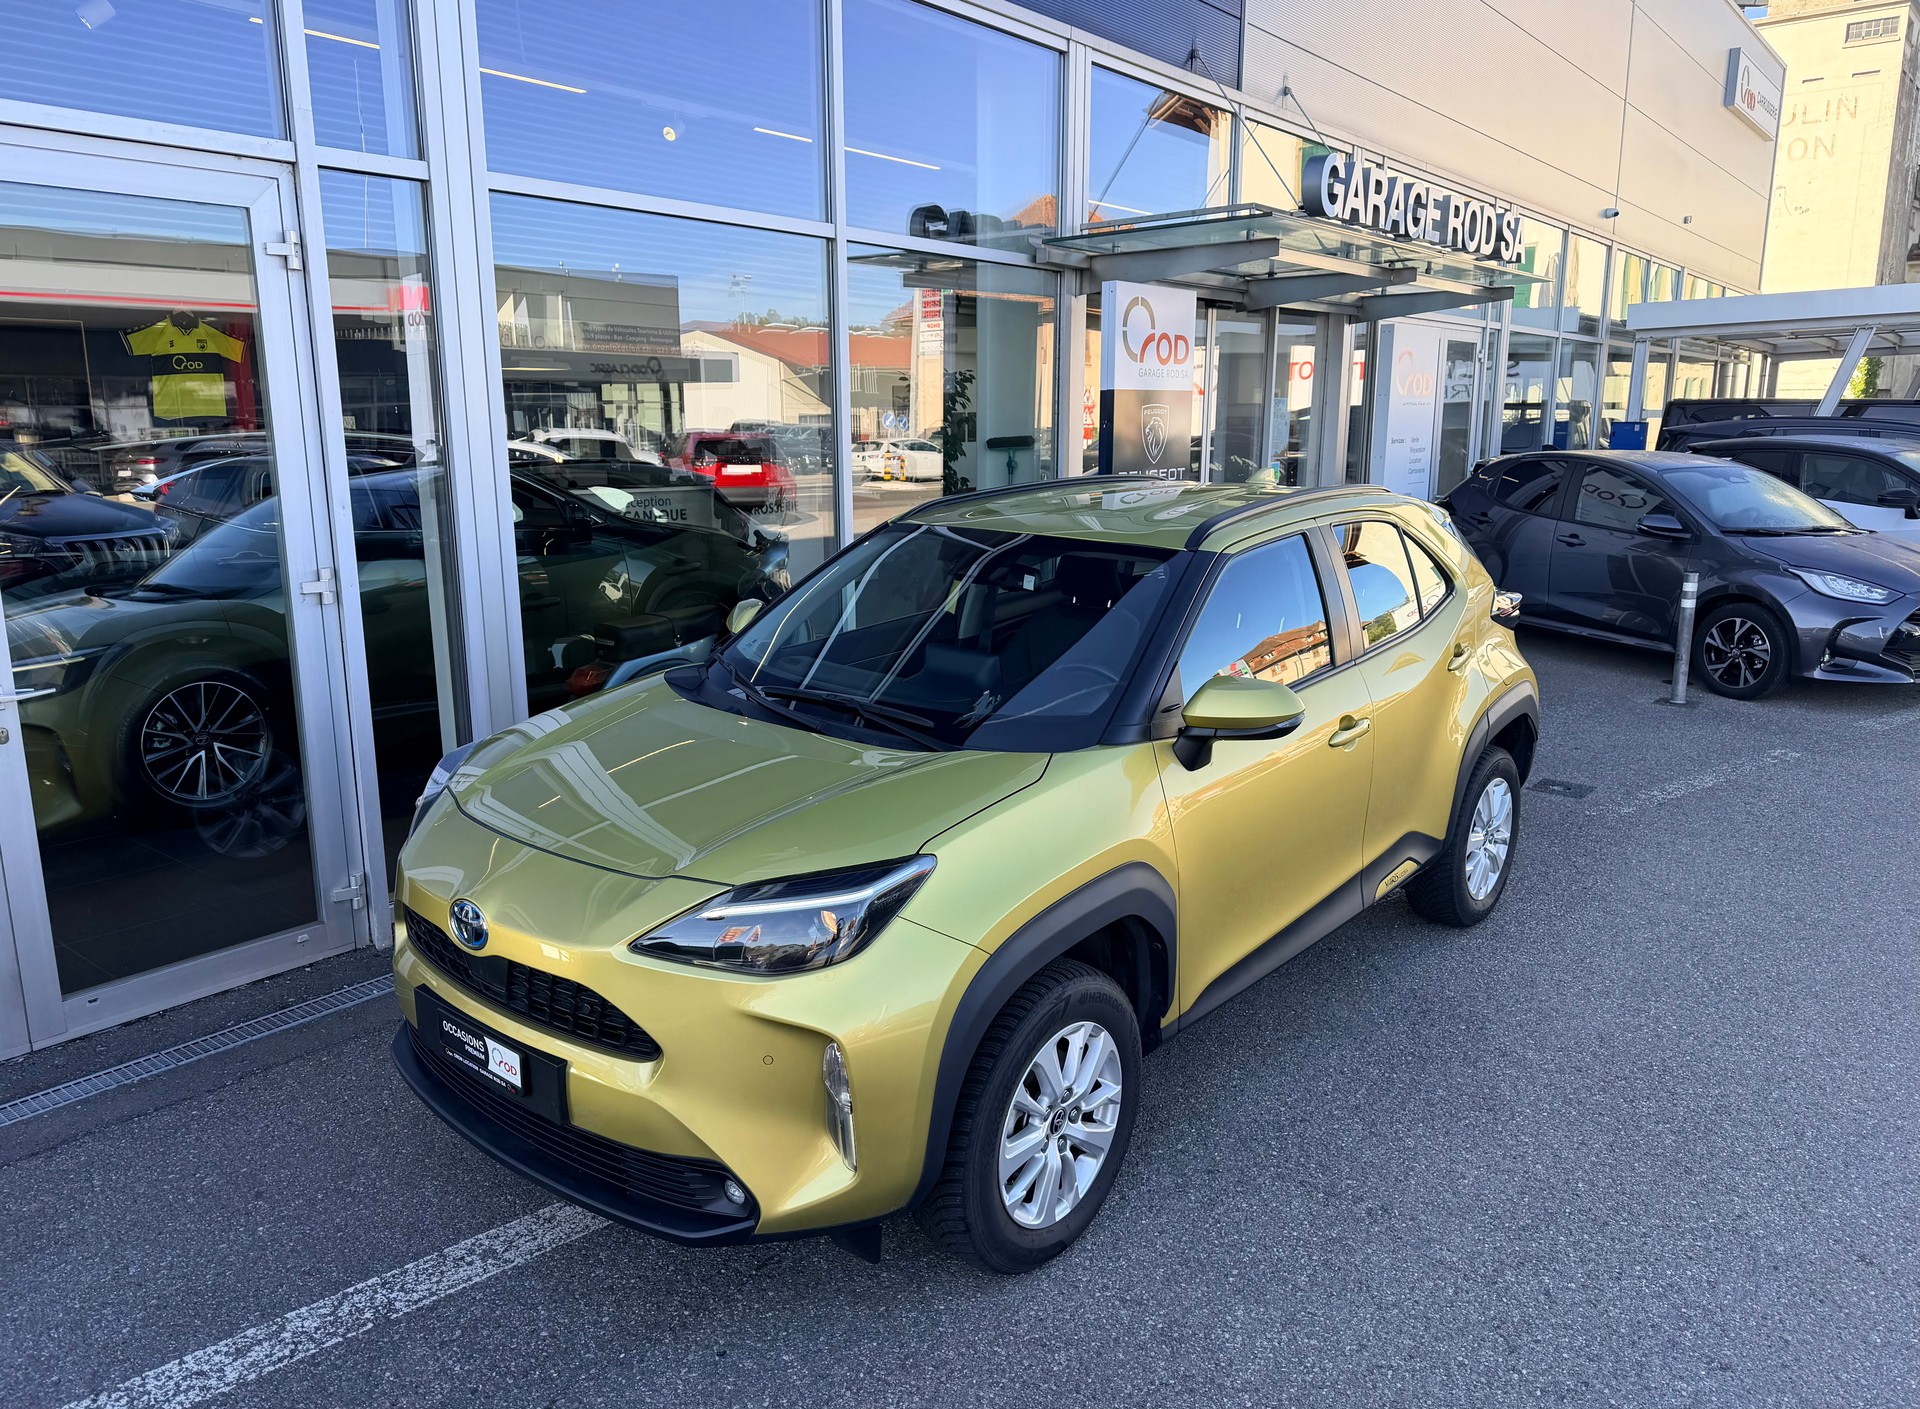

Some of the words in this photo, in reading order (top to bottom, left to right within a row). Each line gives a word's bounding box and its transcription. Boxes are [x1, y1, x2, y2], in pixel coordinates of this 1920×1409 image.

[1320, 152, 1446, 244] GARAGE
[1447, 194, 1497, 256] ROD
[1500, 211, 1526, 265] SA
[1138, 367, 1165, 378] GARAGE
[1166, 369, 1180, 379] ROD
[1181, 370, 1189, 379] SA
[442, 1020, 485, 1052] OCCASIONS
